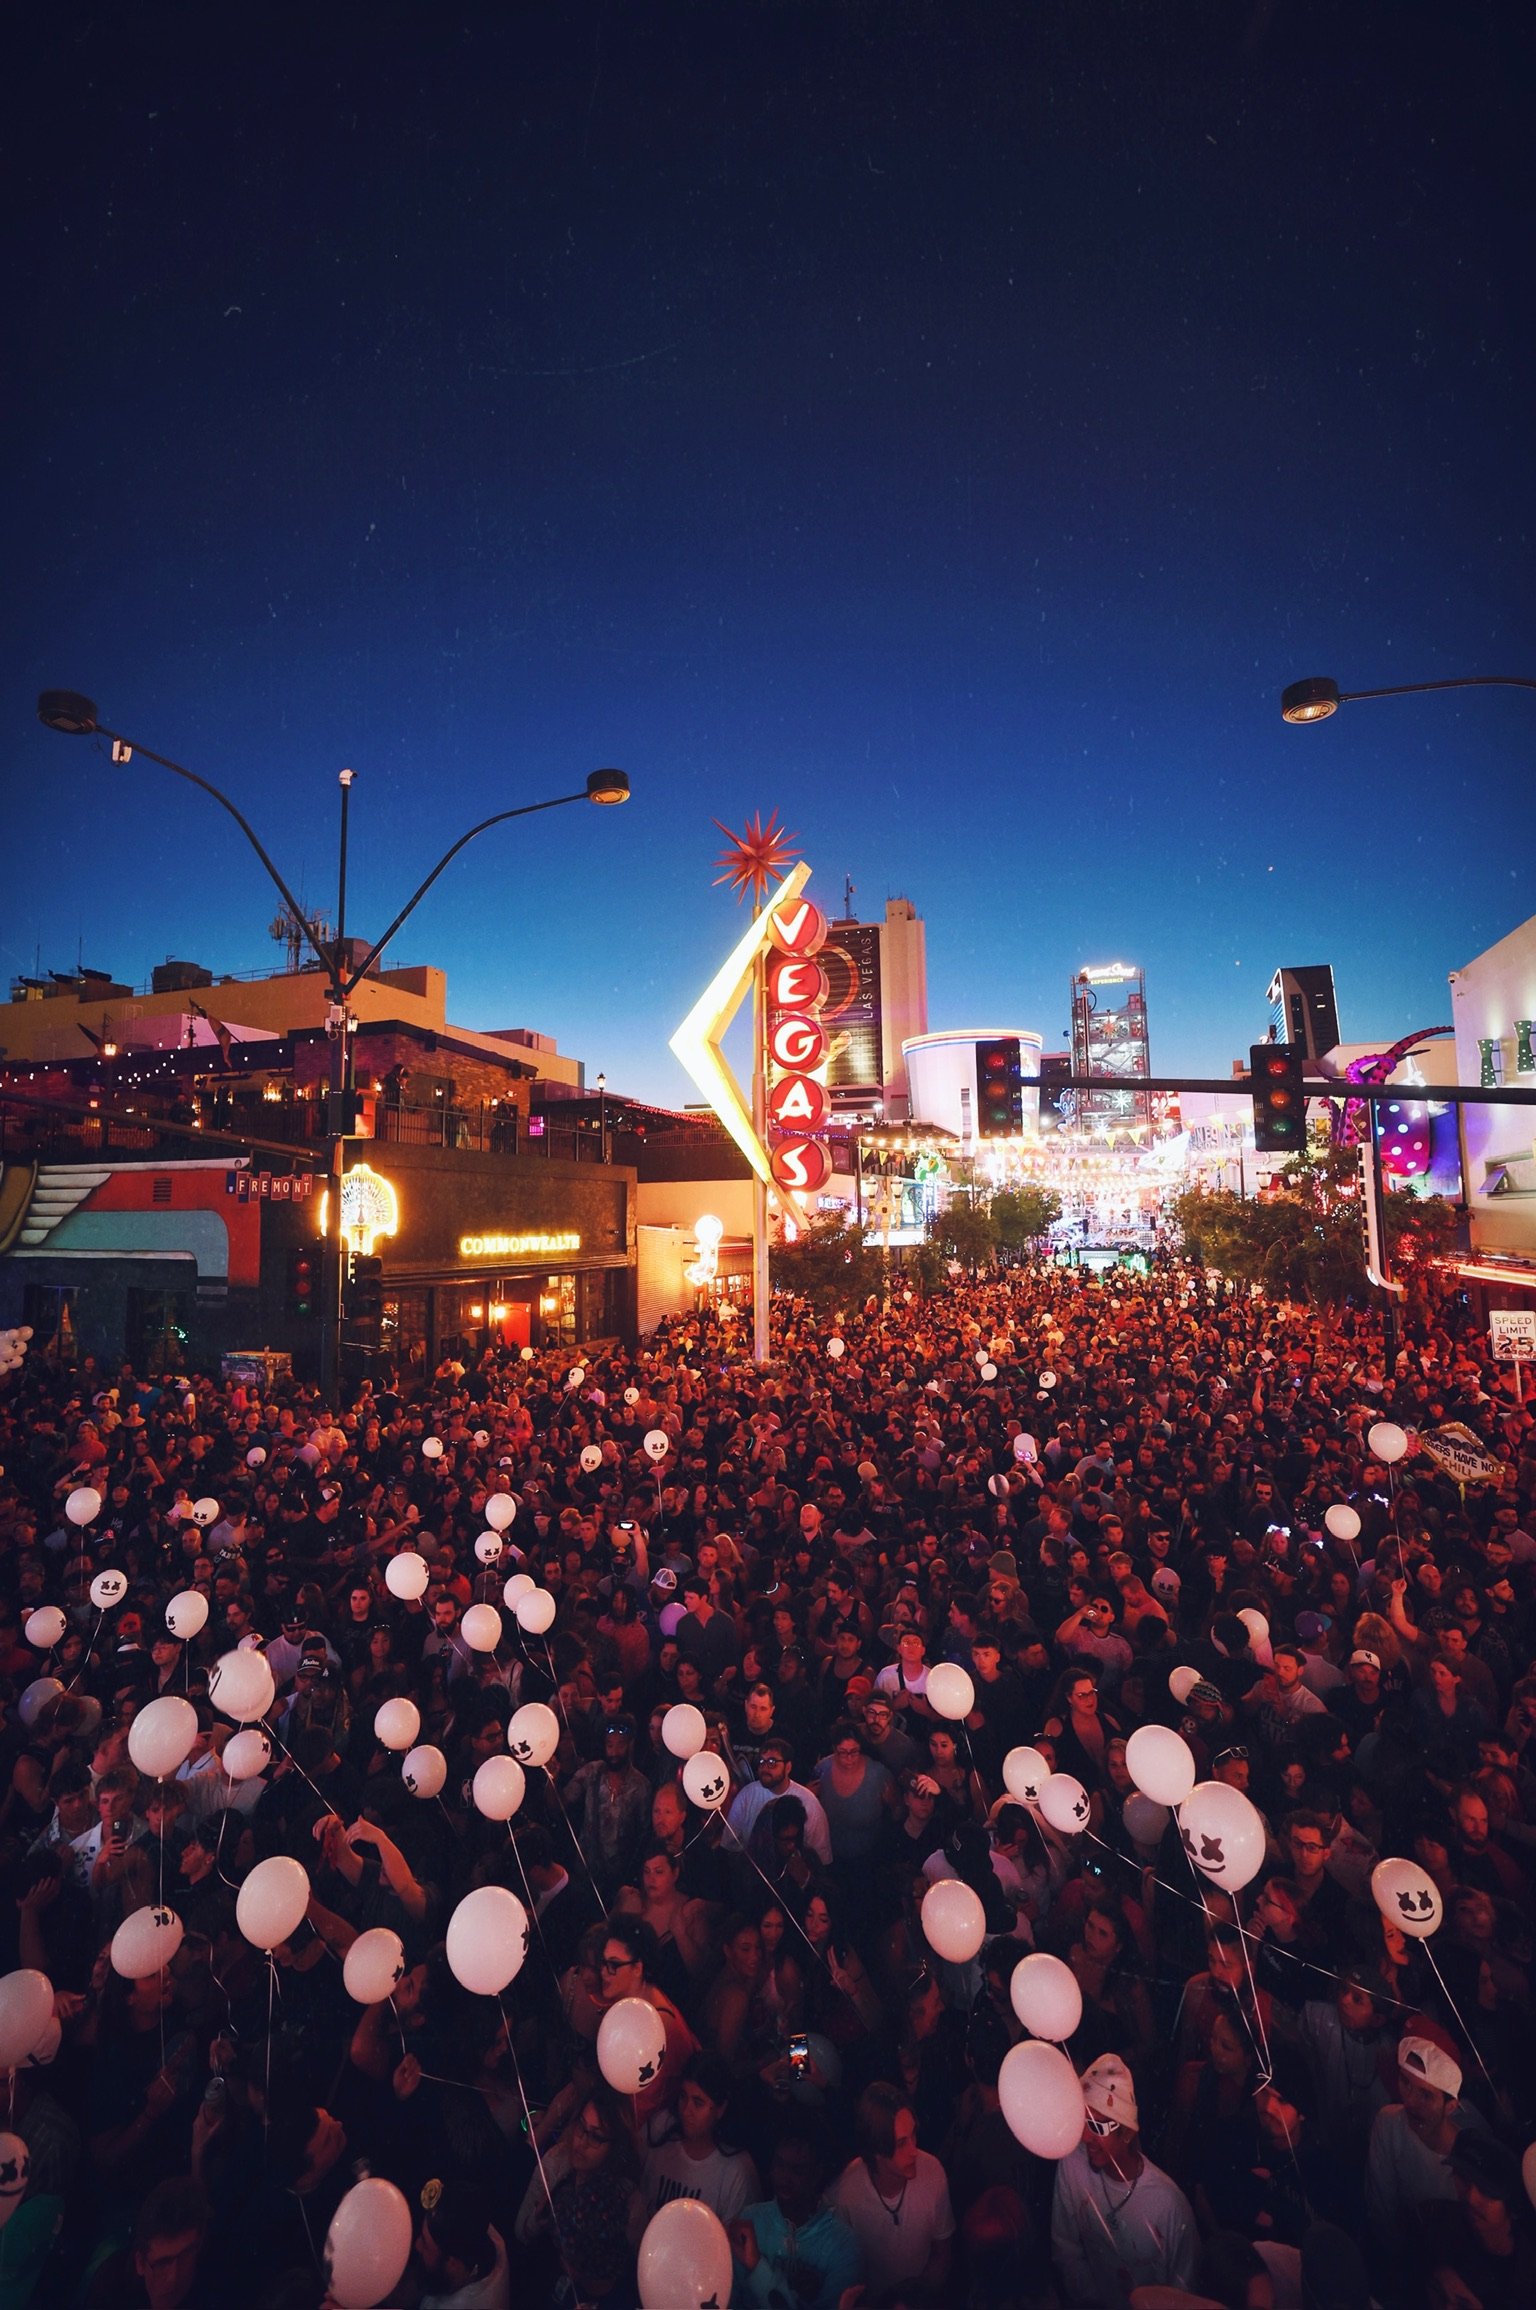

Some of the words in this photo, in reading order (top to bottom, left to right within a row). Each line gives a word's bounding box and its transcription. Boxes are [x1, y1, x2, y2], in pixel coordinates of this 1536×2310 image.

[861, 938, 873, 985] VEGAS
[862, 993, 873, 1019] LAS
[772, 902, 820, 1187] VEGAS
[239, 1180, 310, 1193] FREMONT
[460, 1234, 580, 1255] COMMONWEALTH
[1494, 1316, 1532, 1325] SPEED
[1499, 1326, 1528, 1334] LIMIT
[1453, 1450, 1478, 1469] HAVE
[1481, 1461, 1495, 1473] NO
